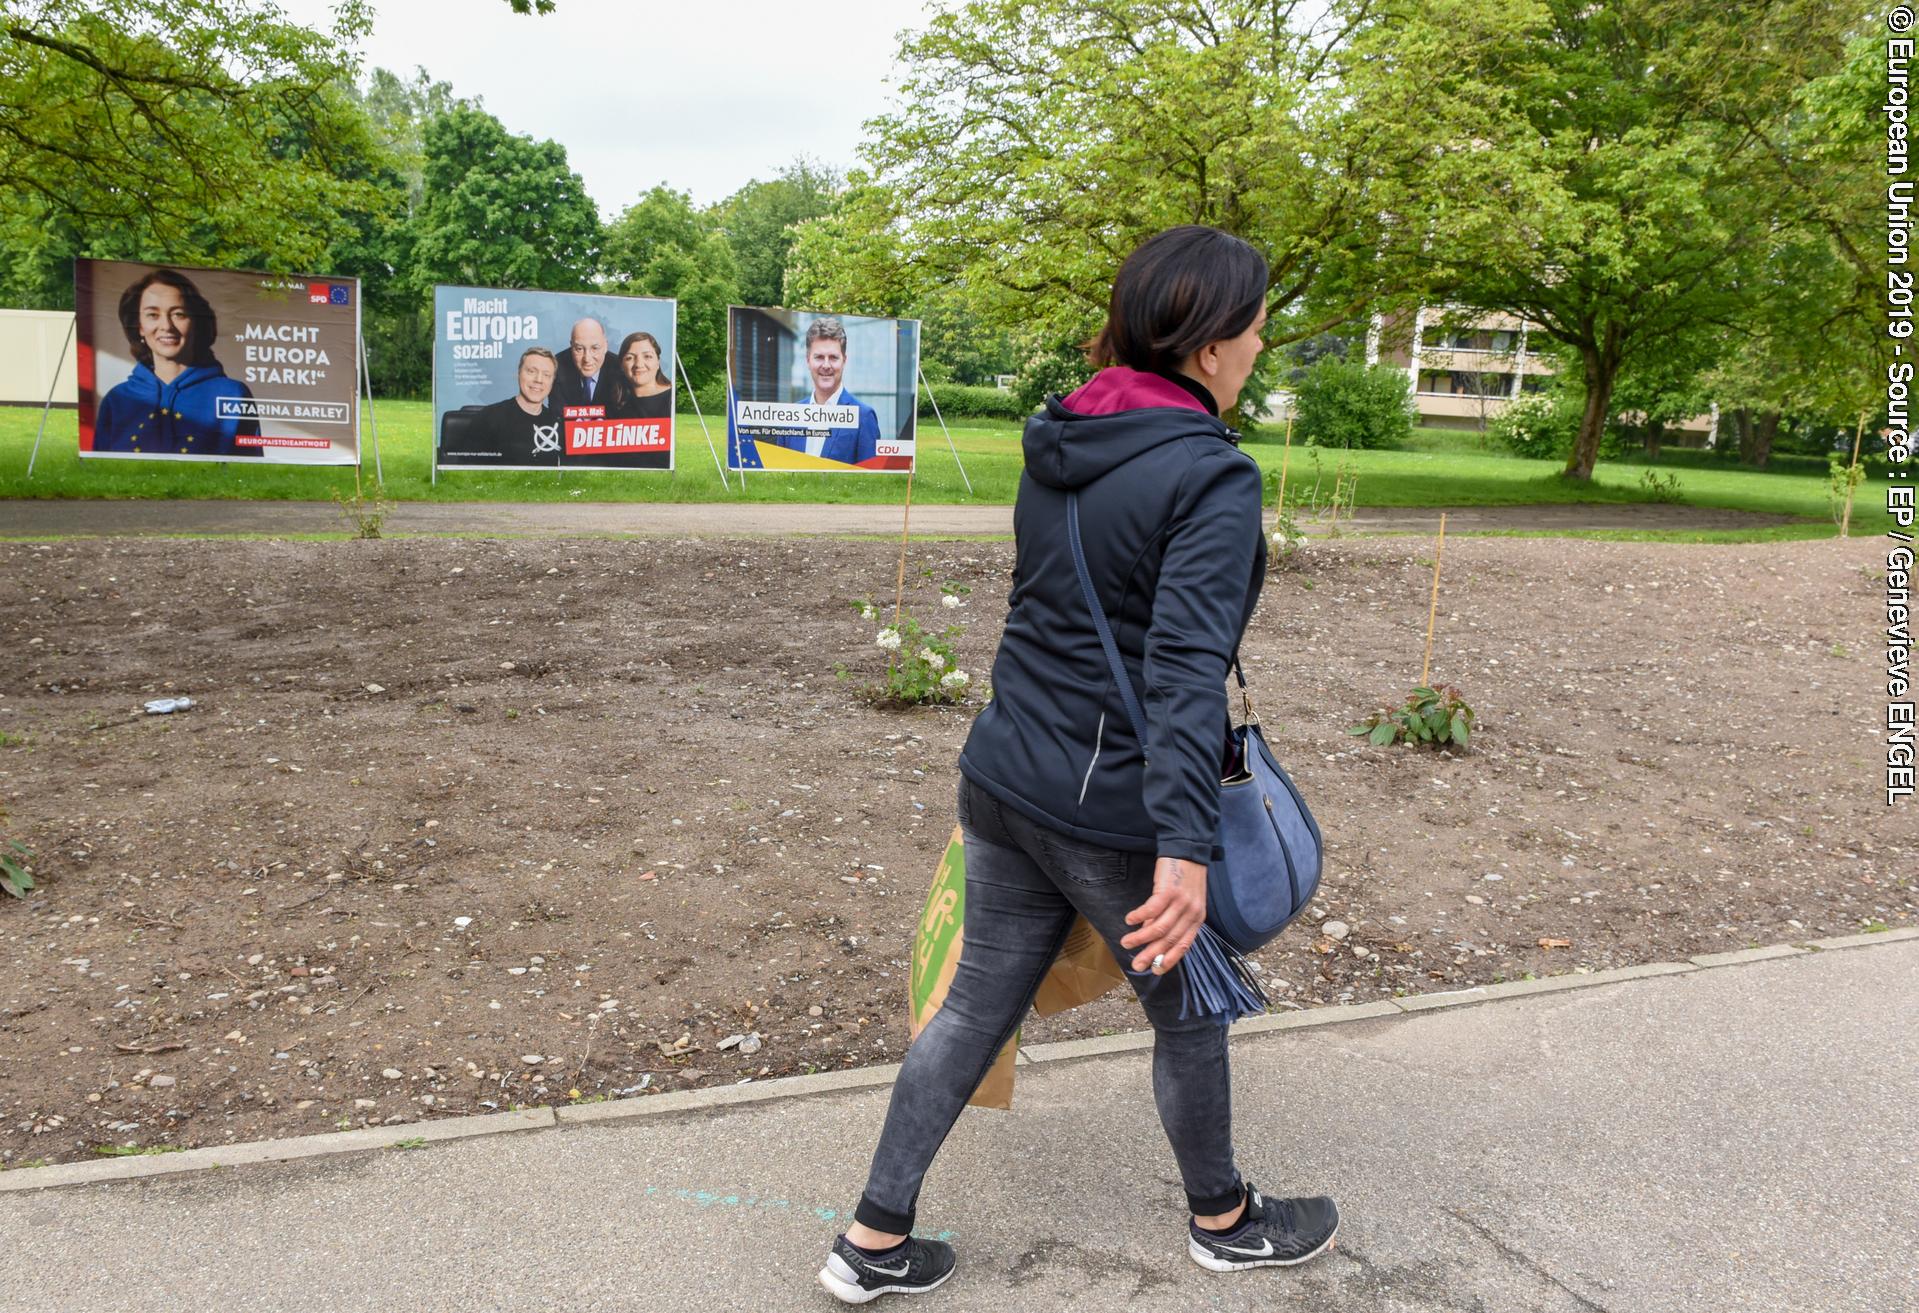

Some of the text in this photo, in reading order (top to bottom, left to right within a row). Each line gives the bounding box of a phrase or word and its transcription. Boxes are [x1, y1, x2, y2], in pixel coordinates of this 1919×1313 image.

[310, 295, 328, 303] SPD
[464, 298, 508, 314] Macht
[446, 311, 538, 344] Europa
[245, 345, 331, 366] EUROPA
[453, 341, 503, 359] sozial!
[222, 402, 343, 418] KATARINA BARLEY
[566, 408, 578, 417] Am
[742, 405, 854, 424] Andreas Schwab
[573, 426, 604, 448] DIE
[877, 446, 900, 454] CDU
